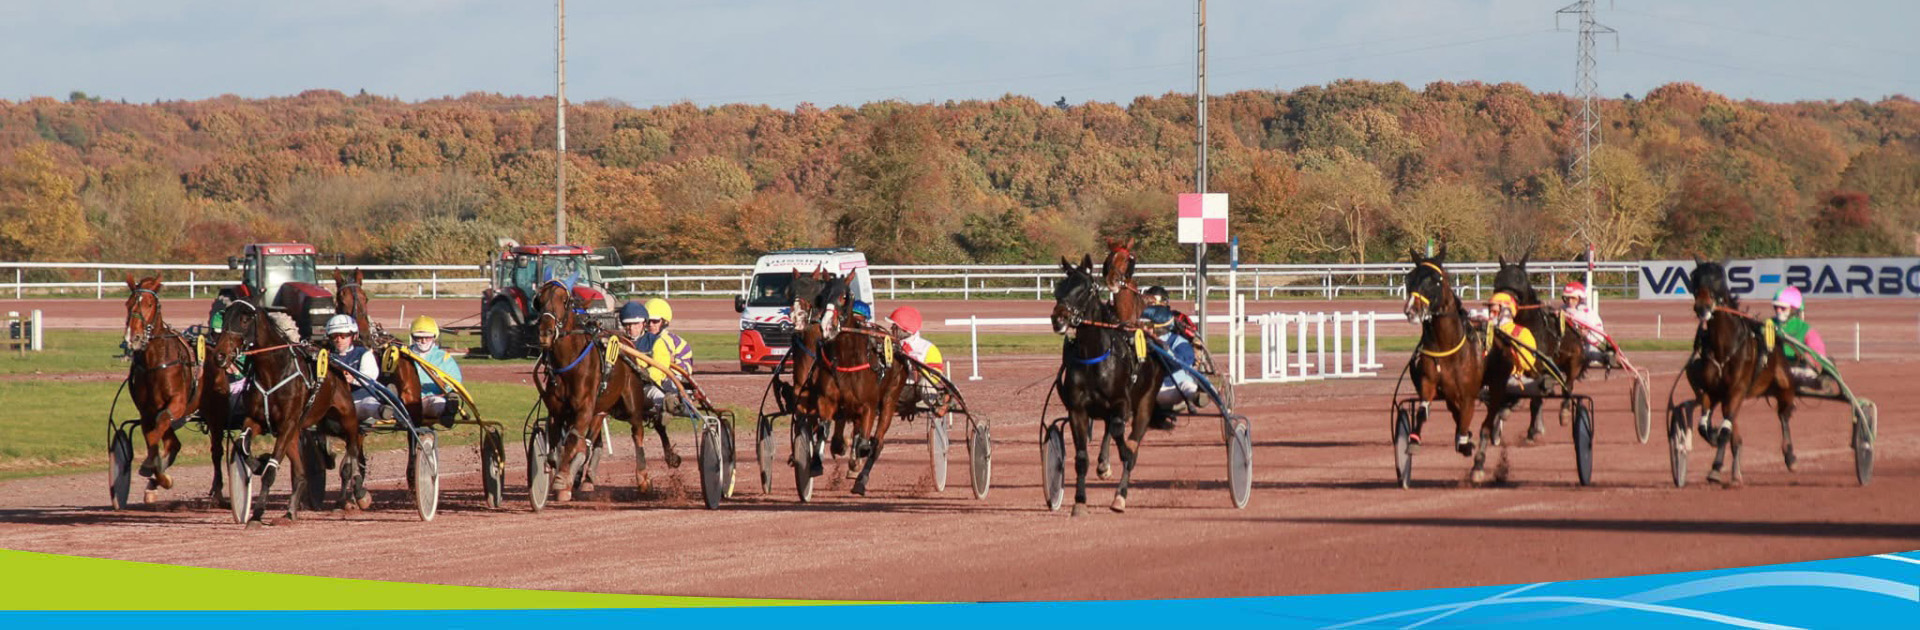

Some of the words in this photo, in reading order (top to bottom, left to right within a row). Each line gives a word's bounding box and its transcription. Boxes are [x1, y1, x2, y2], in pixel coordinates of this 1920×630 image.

[1641, 264, 1920, 295] VAS-BARBO
[387, 348, 396, 371] 5
[608, 339, 619, 362] 10
